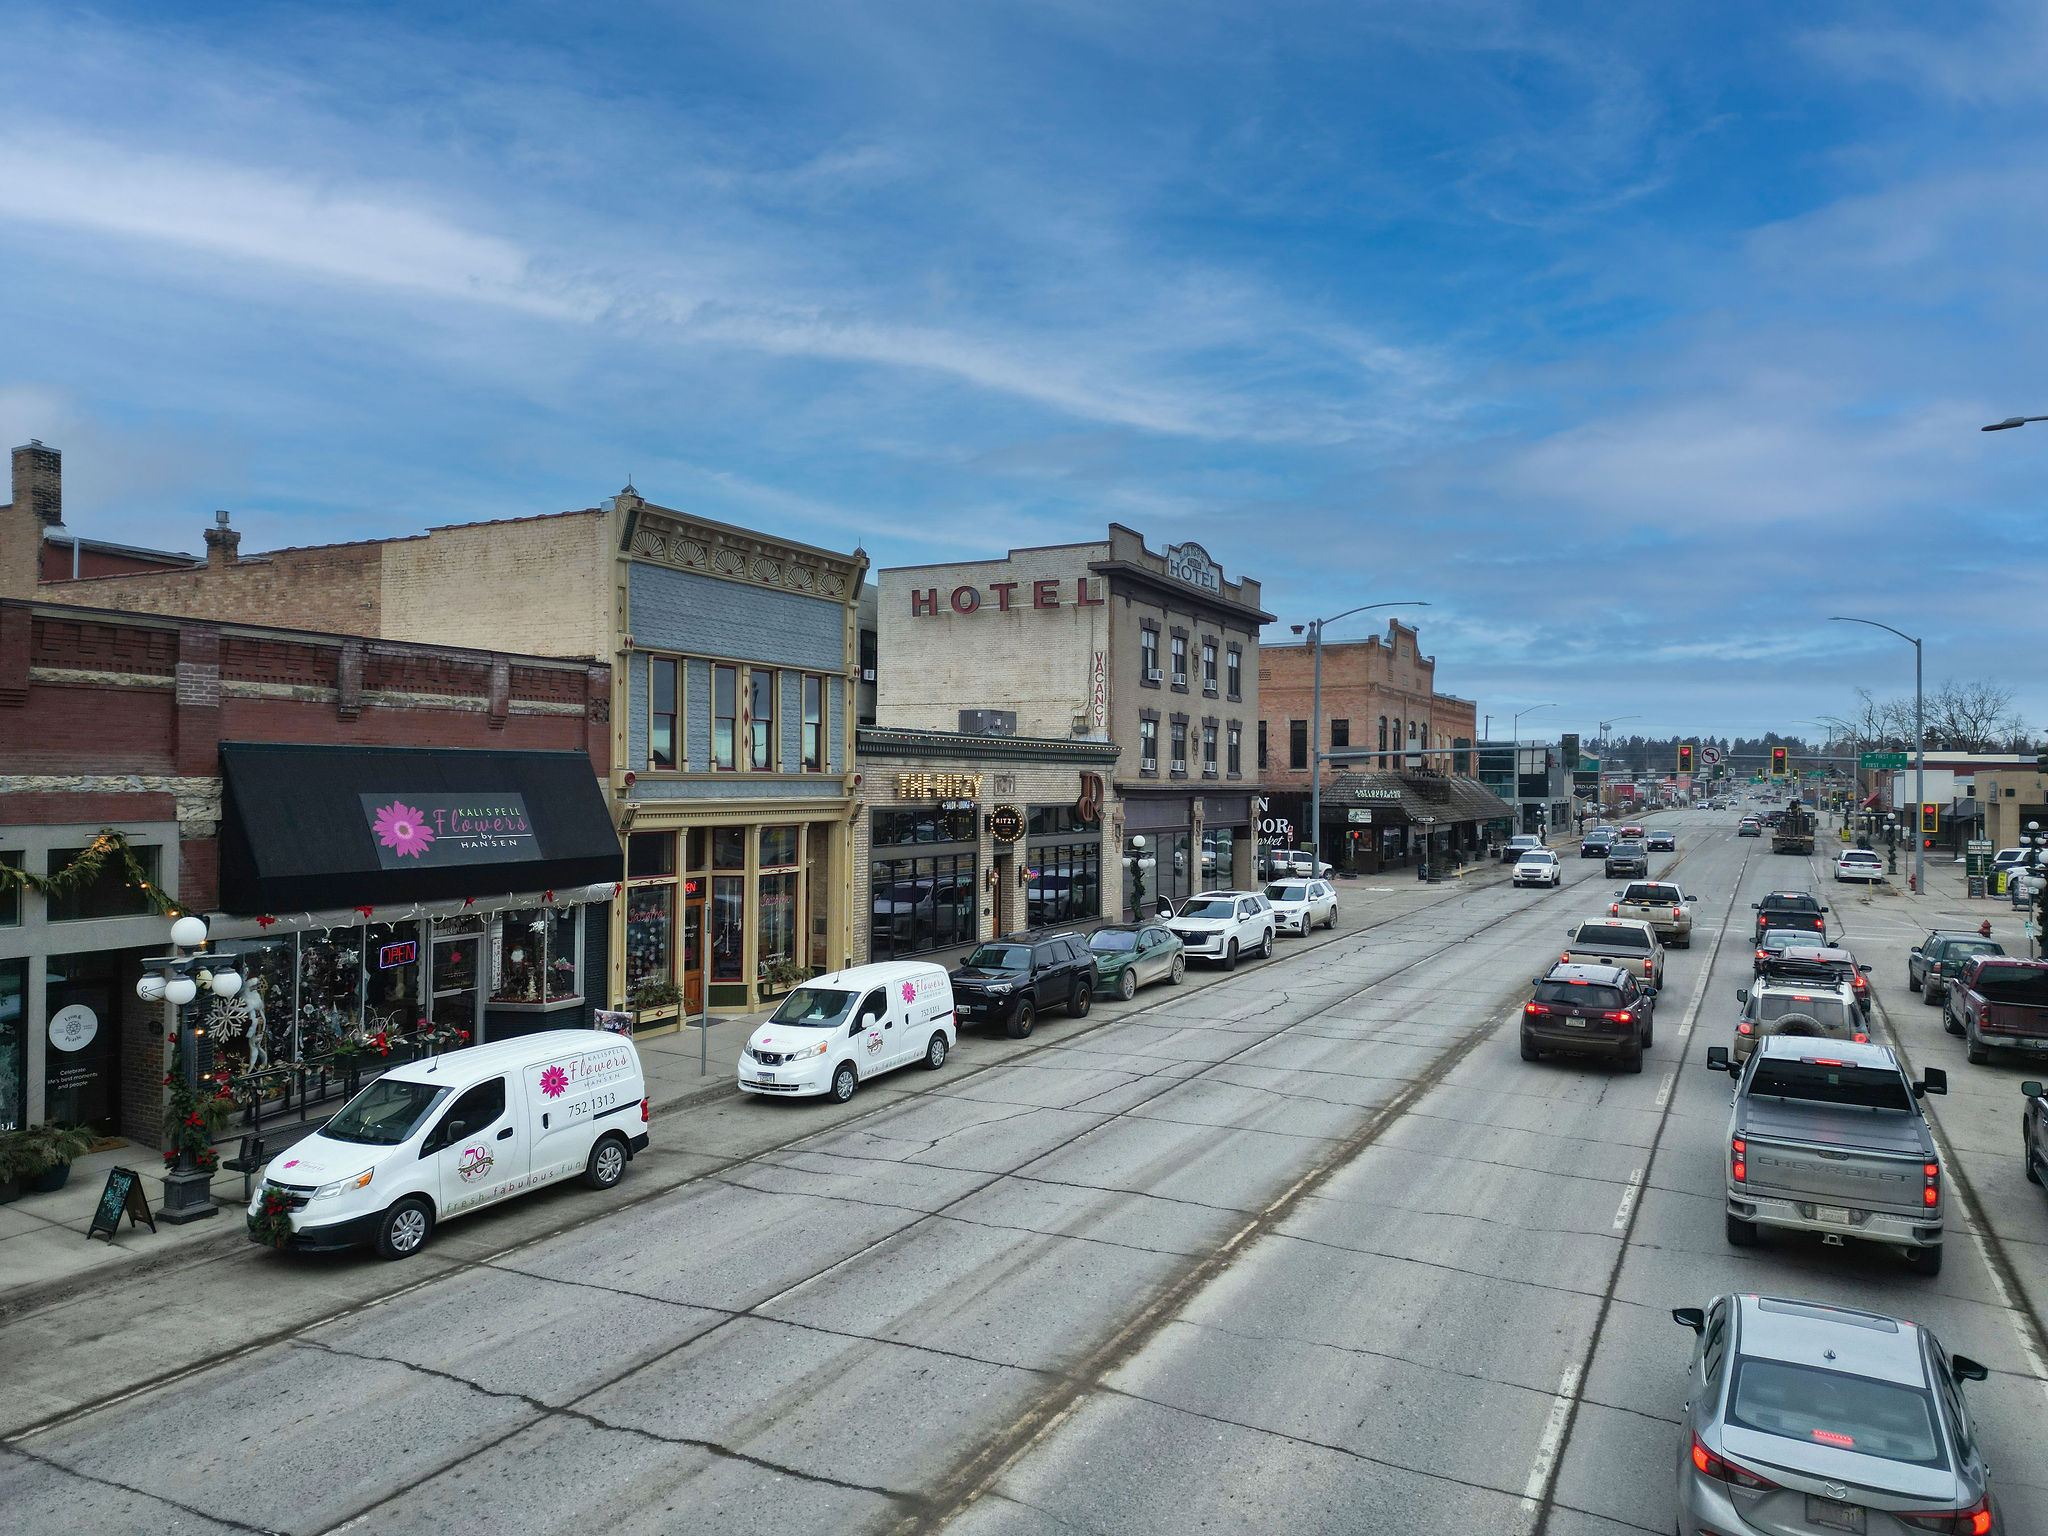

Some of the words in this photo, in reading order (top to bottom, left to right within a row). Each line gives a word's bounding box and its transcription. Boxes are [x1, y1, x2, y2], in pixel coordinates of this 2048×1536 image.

[1170, 559, 1217, 590] HOTEL
[911, 577, 1104, 617] HOTEL
[1095, 652, 1104, 728] VACANCY
[898, 773, 931, 798] THE
[936, 774, 984, 798] RITZY
[432, 808, 527, 834] Flowers
[458, 807, 521, 817] KALISPELL
[460, 839, 518, 848] HANSEN
[480, 832, 493, 840] by
[1257, 835, 1285, 846] arket
[383, 943, 415, 966] OPEN
[915, 978, 945, 993] Flowers
[569, 1054, 627, 1081] Flowers
[587, 1048, 624, 1062] KALISPELL
[568, 1092, 616, 1118] 752.1313
[1757, 1156, 1912, 1184] CHEVROLET
